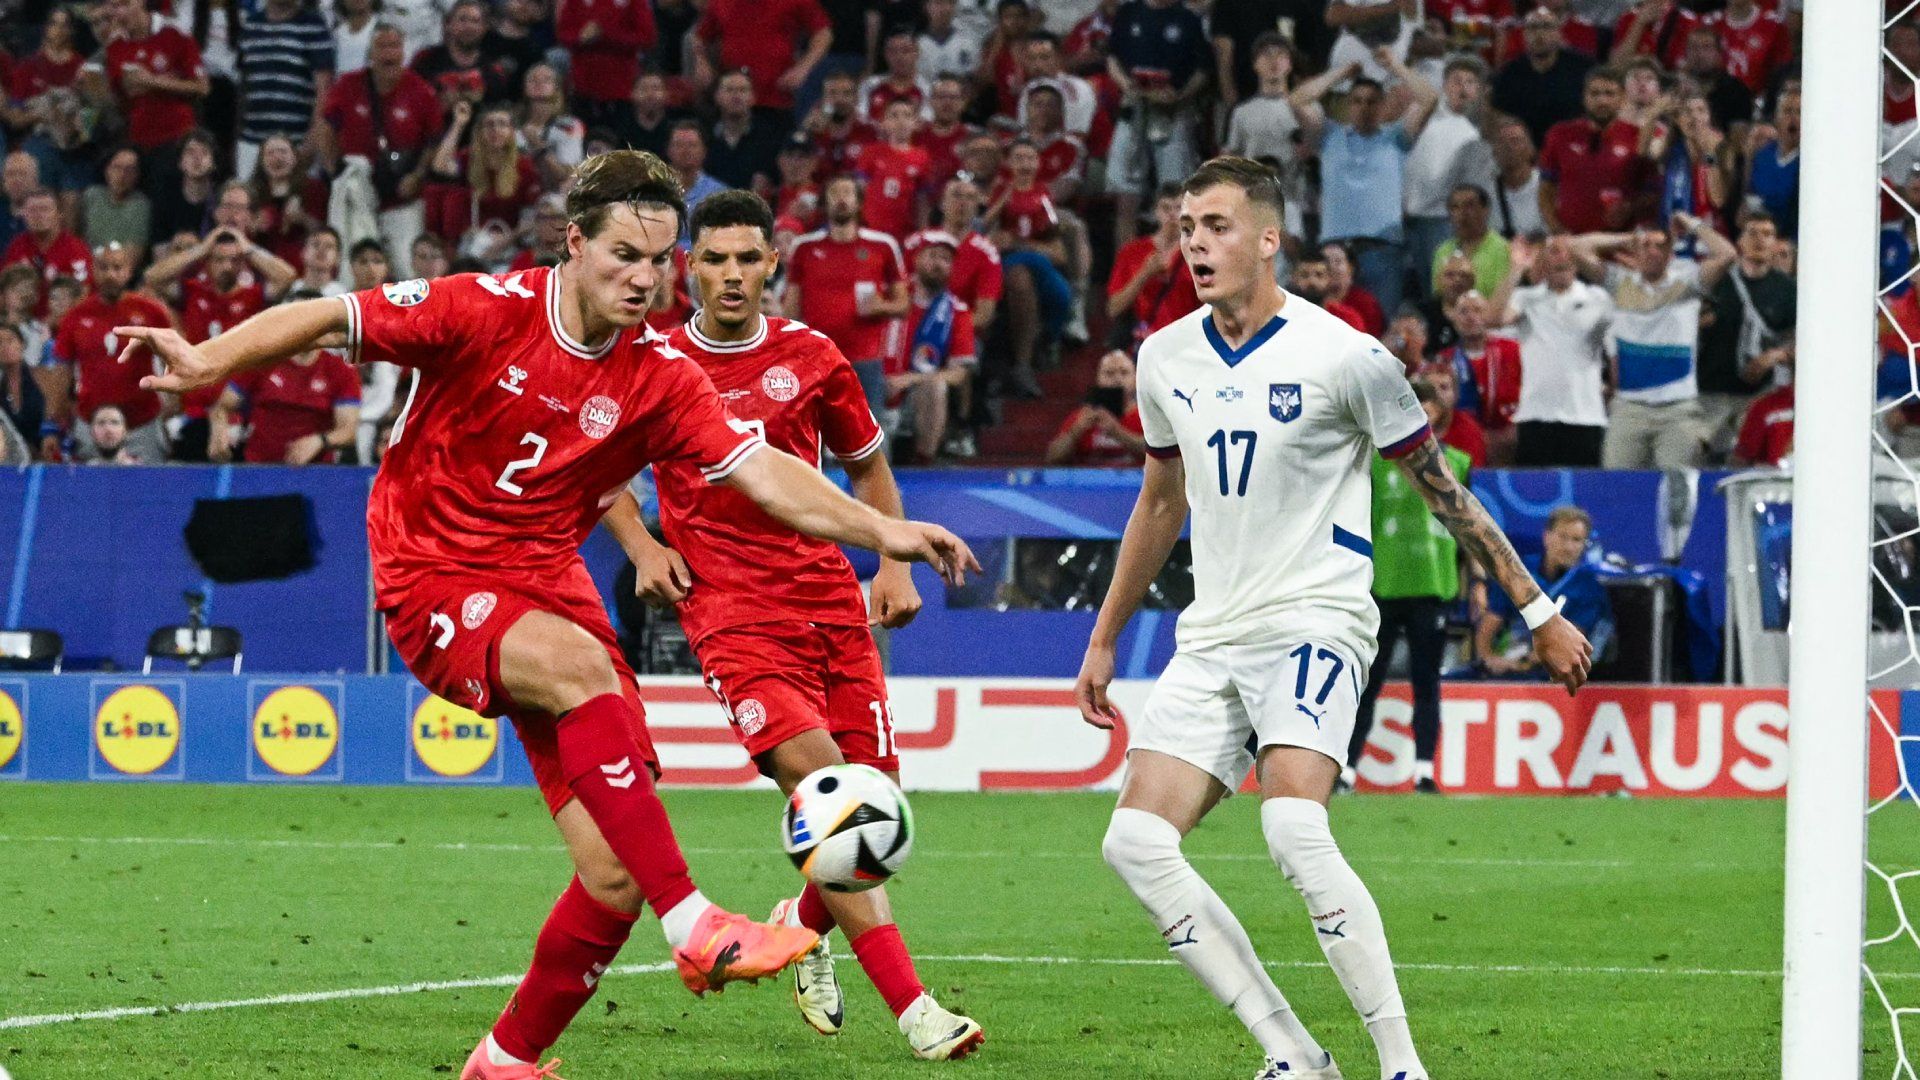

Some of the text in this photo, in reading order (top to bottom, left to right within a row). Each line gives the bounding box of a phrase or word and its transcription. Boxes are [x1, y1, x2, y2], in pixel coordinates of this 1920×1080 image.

[587, 407, 614, 426] DBU
[495, 431, 549, 497] 2
[1207, 429, 1257, 497] 17
[1289, 643, 1344, 705] 17
